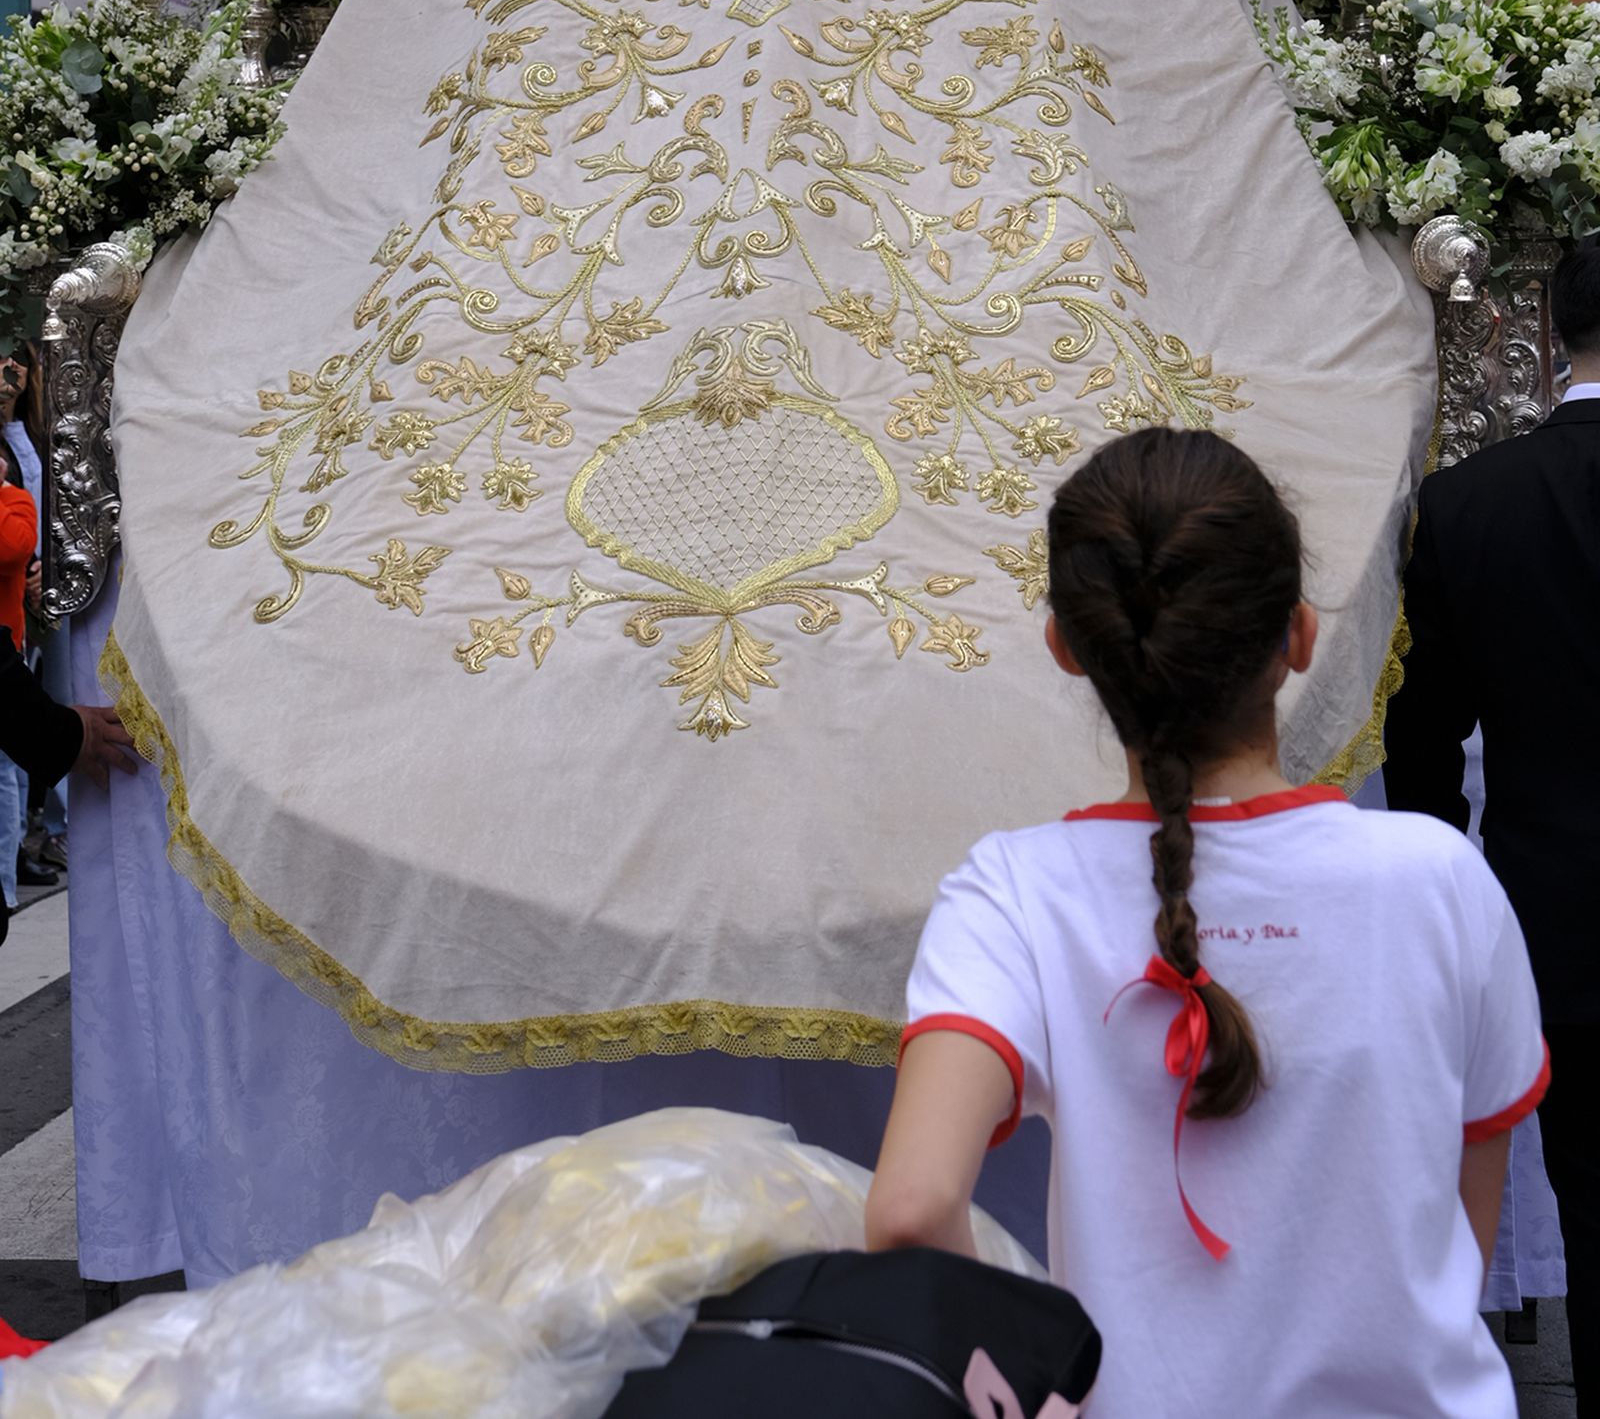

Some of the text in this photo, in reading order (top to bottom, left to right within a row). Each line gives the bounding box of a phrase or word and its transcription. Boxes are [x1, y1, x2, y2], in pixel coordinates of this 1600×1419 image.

[1197, 923, 1299, 946] oria y Paz
